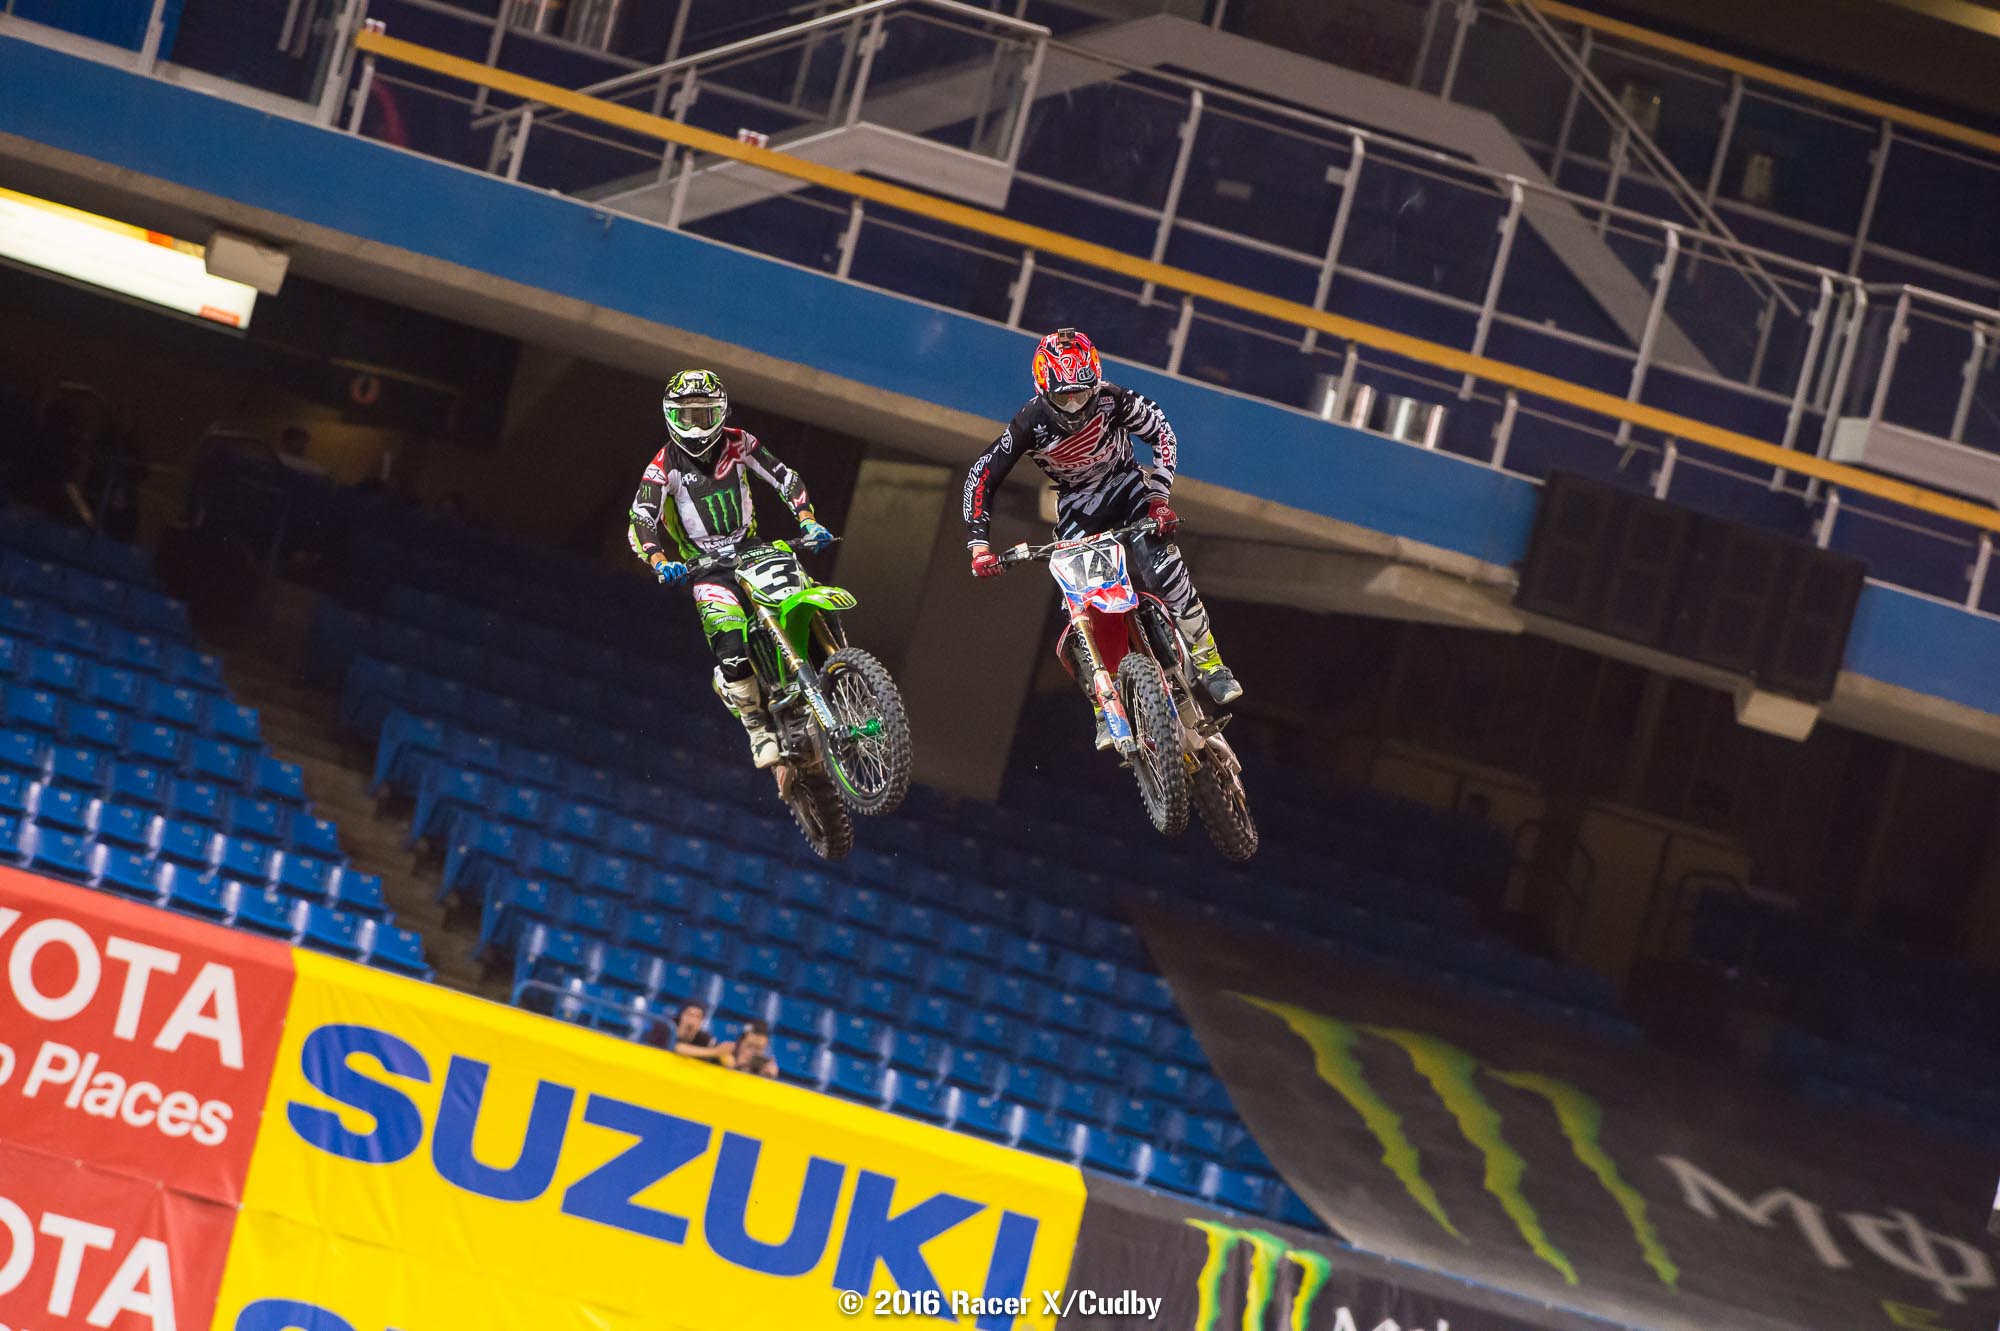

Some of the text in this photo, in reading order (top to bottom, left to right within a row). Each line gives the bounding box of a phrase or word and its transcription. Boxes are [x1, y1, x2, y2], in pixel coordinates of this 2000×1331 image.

[755, 559, 800, 595] 3
[1067, 548, 1117, 592] 14
[803, 688, 830, 728] DUNLOP
[22, 1040, 234, 1146] Places
[286, 1023, 1040, 1330] SUZUKI
